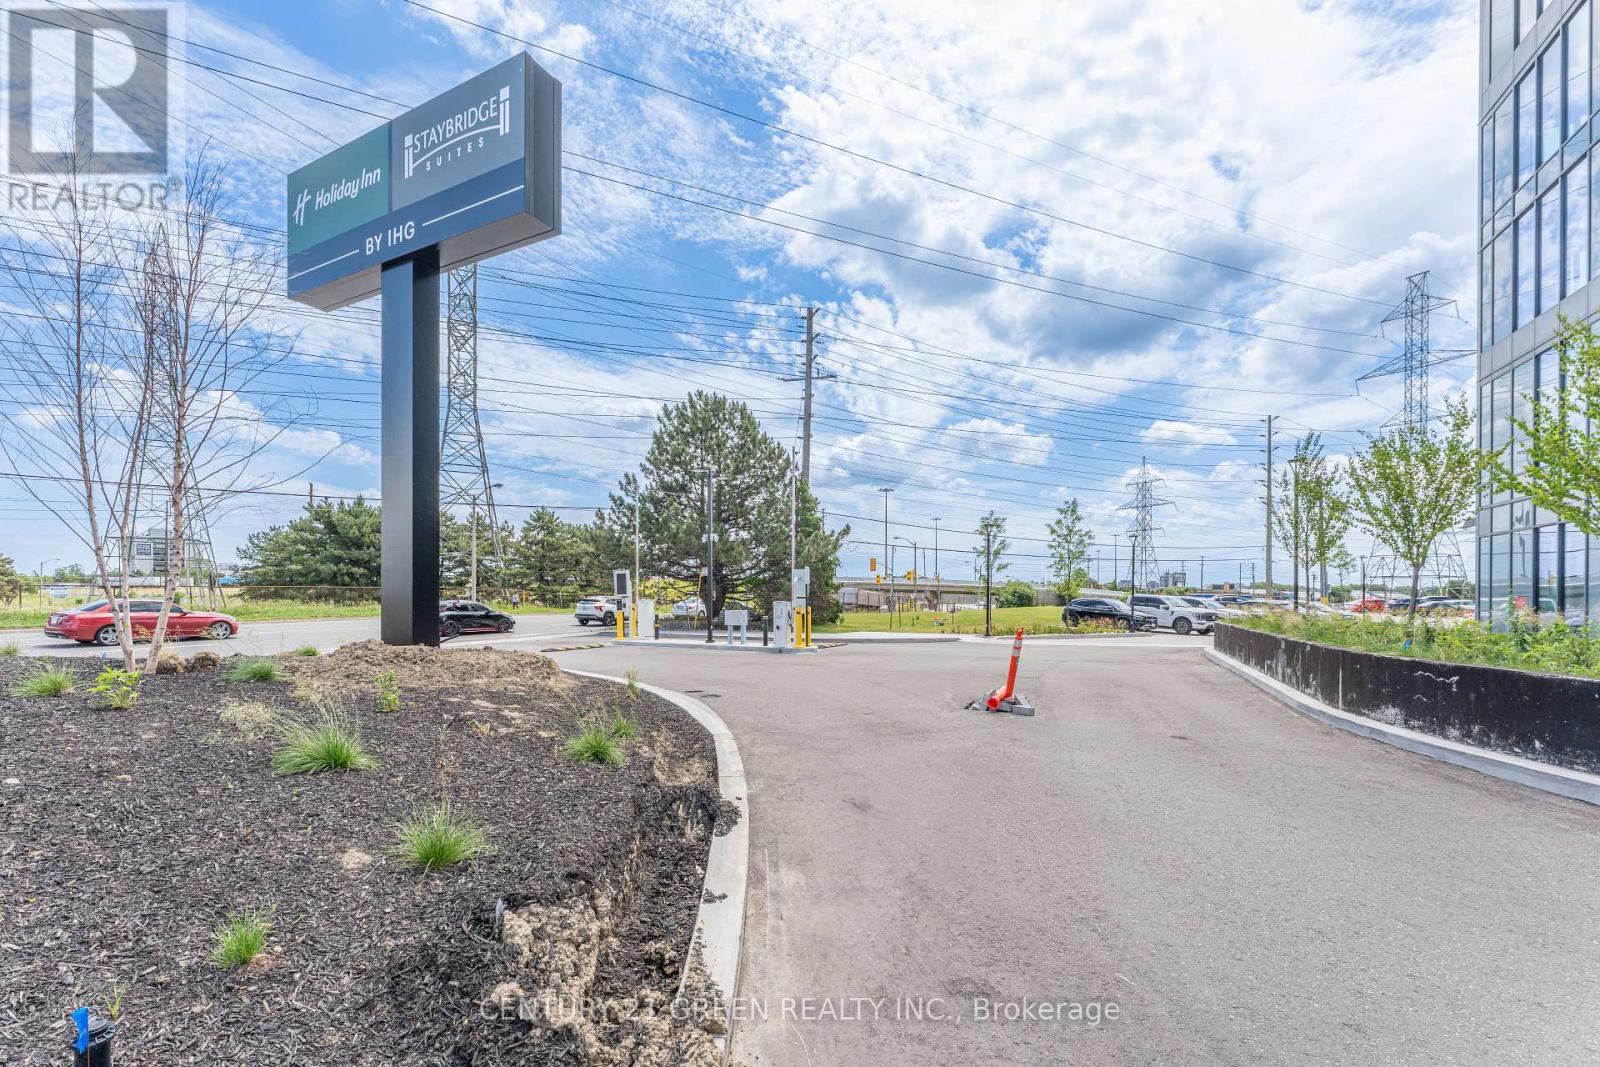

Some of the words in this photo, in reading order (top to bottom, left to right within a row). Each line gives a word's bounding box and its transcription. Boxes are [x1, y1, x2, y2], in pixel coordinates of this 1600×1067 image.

[414, 96, 498, 153] STAYBRIDGE
[426, 137, 484, 171] SUITES
[315, 178, 360, 211] Holiday
[361, 168, 381, 189] Inn
[366, 233, 382, 255] BY
[388, 221, 415, 247] IHG
